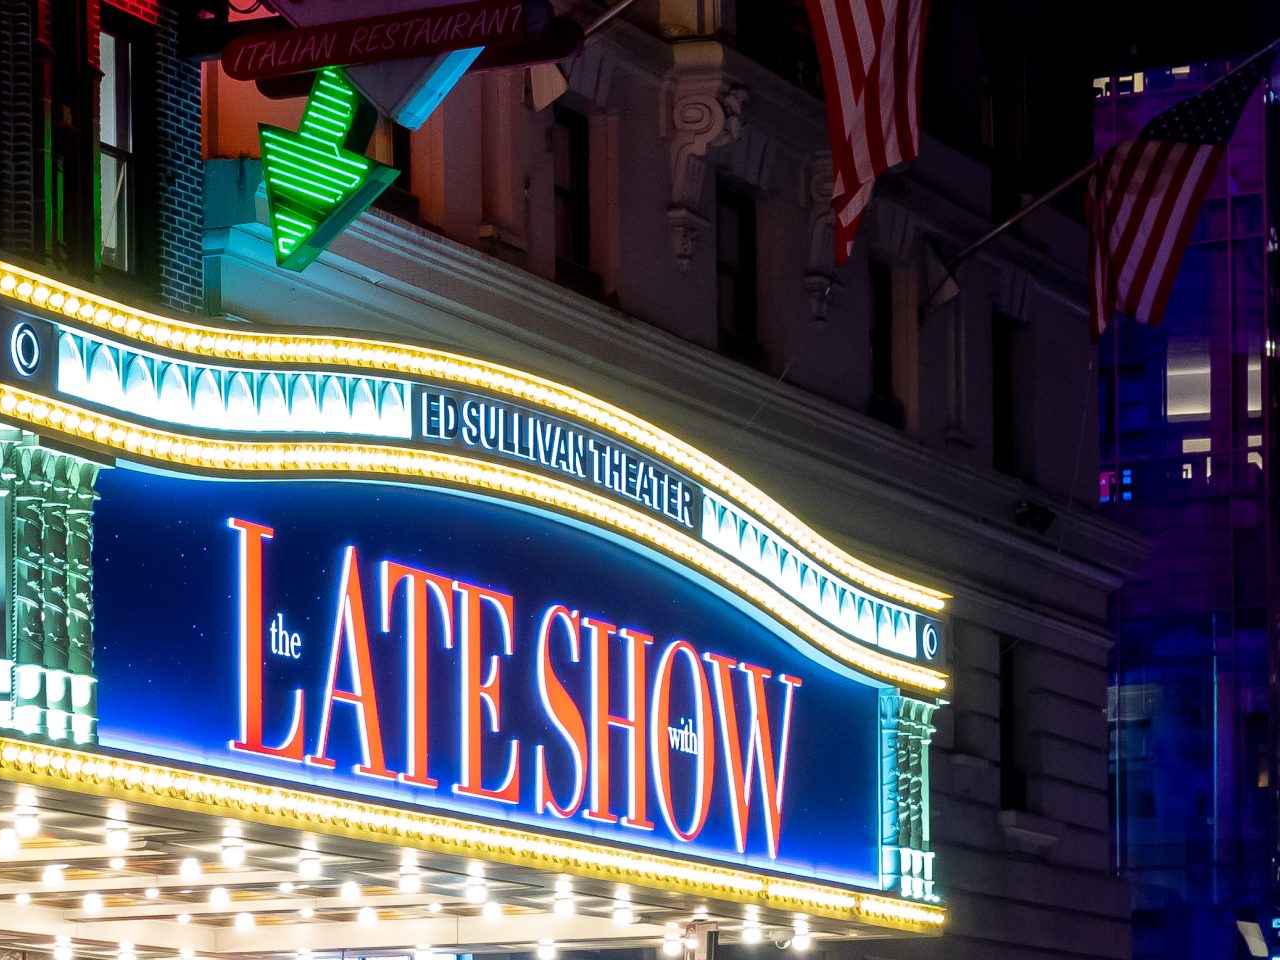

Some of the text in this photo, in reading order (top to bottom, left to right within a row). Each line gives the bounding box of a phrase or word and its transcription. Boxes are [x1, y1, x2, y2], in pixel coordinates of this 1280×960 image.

[233, 6, 522, 72] ITALIAN RESTAURANT
[421, 391, 694, 529] ED SULLIVAN THEATER
[269, 613, 302, 660] the
[228, 517, 803, 860] LATE SHOW
[667, 716, 699, 756] with
